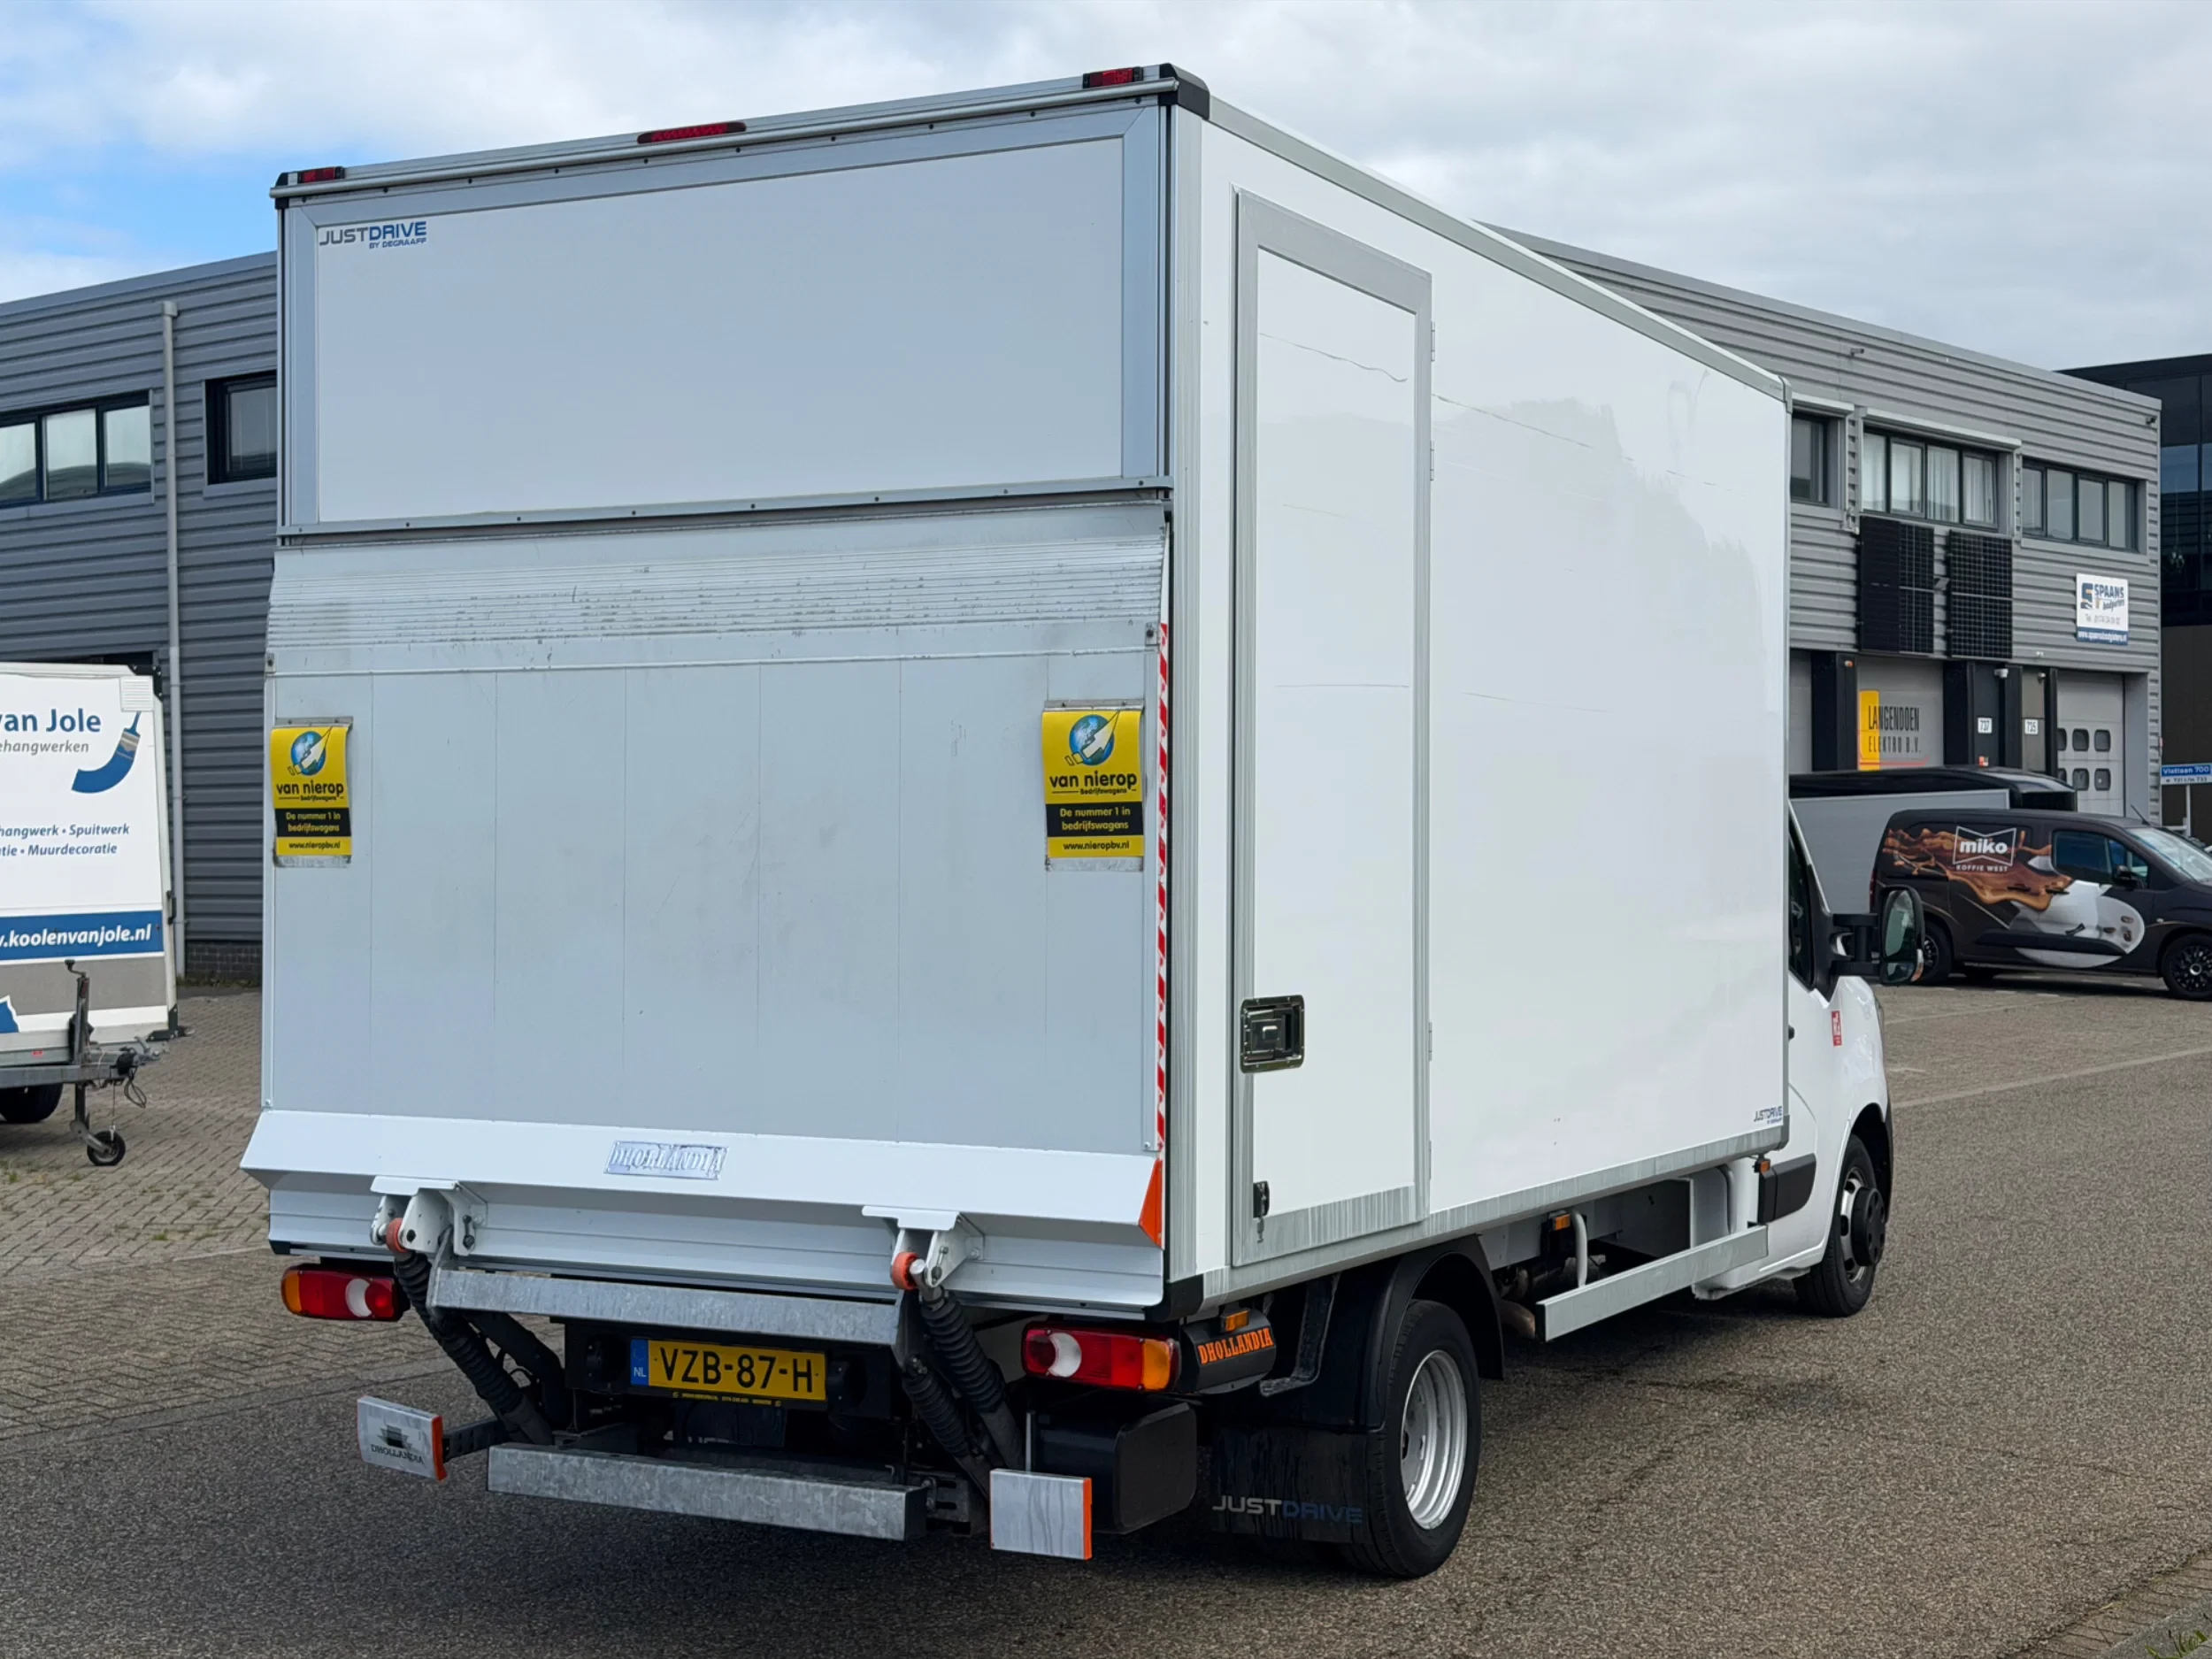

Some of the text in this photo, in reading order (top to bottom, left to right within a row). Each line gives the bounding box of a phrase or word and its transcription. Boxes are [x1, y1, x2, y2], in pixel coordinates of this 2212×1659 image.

[319, 220, 427, 246] JUSTDRIVE
[2094, 584, 2124, 598] SPAANS
[46, 708, 102, 733] Jole
[1868, 705, 1920, 732] LANGENDOEN
[1980, 719, 1991, 732] 737
[1868, 736, 1902, 753] ELEKTRO
[276, 779, 344, 797] van nierop
[1049, 770, 1138, 790] van nierop
[297, 811, 326, 820] nummer
[1060, 809, 1072, 818] De
[1075, 807, 1112, 817] nummer
[1122, 806, 1131, 816] in
[68, 823, 131, 839] Spuitwerk
[1062, 821, 1129, 832] bedrijfswagens
[27, 842, 118, 856] Muurdecoratie
[1064, 841, 1130, 851] www.nieropbv.nl
[1959, 838, 2008, 855] miko
[1197, 1327, 1275, 1365] DHOLLANDIA
[633, 1347, 813, 1394] NL VZB-87-H
[370, 1443, 426, 1465] DHOLLANDIA
[1212, 1495, 1363, 1524] JUSTDRIVE
